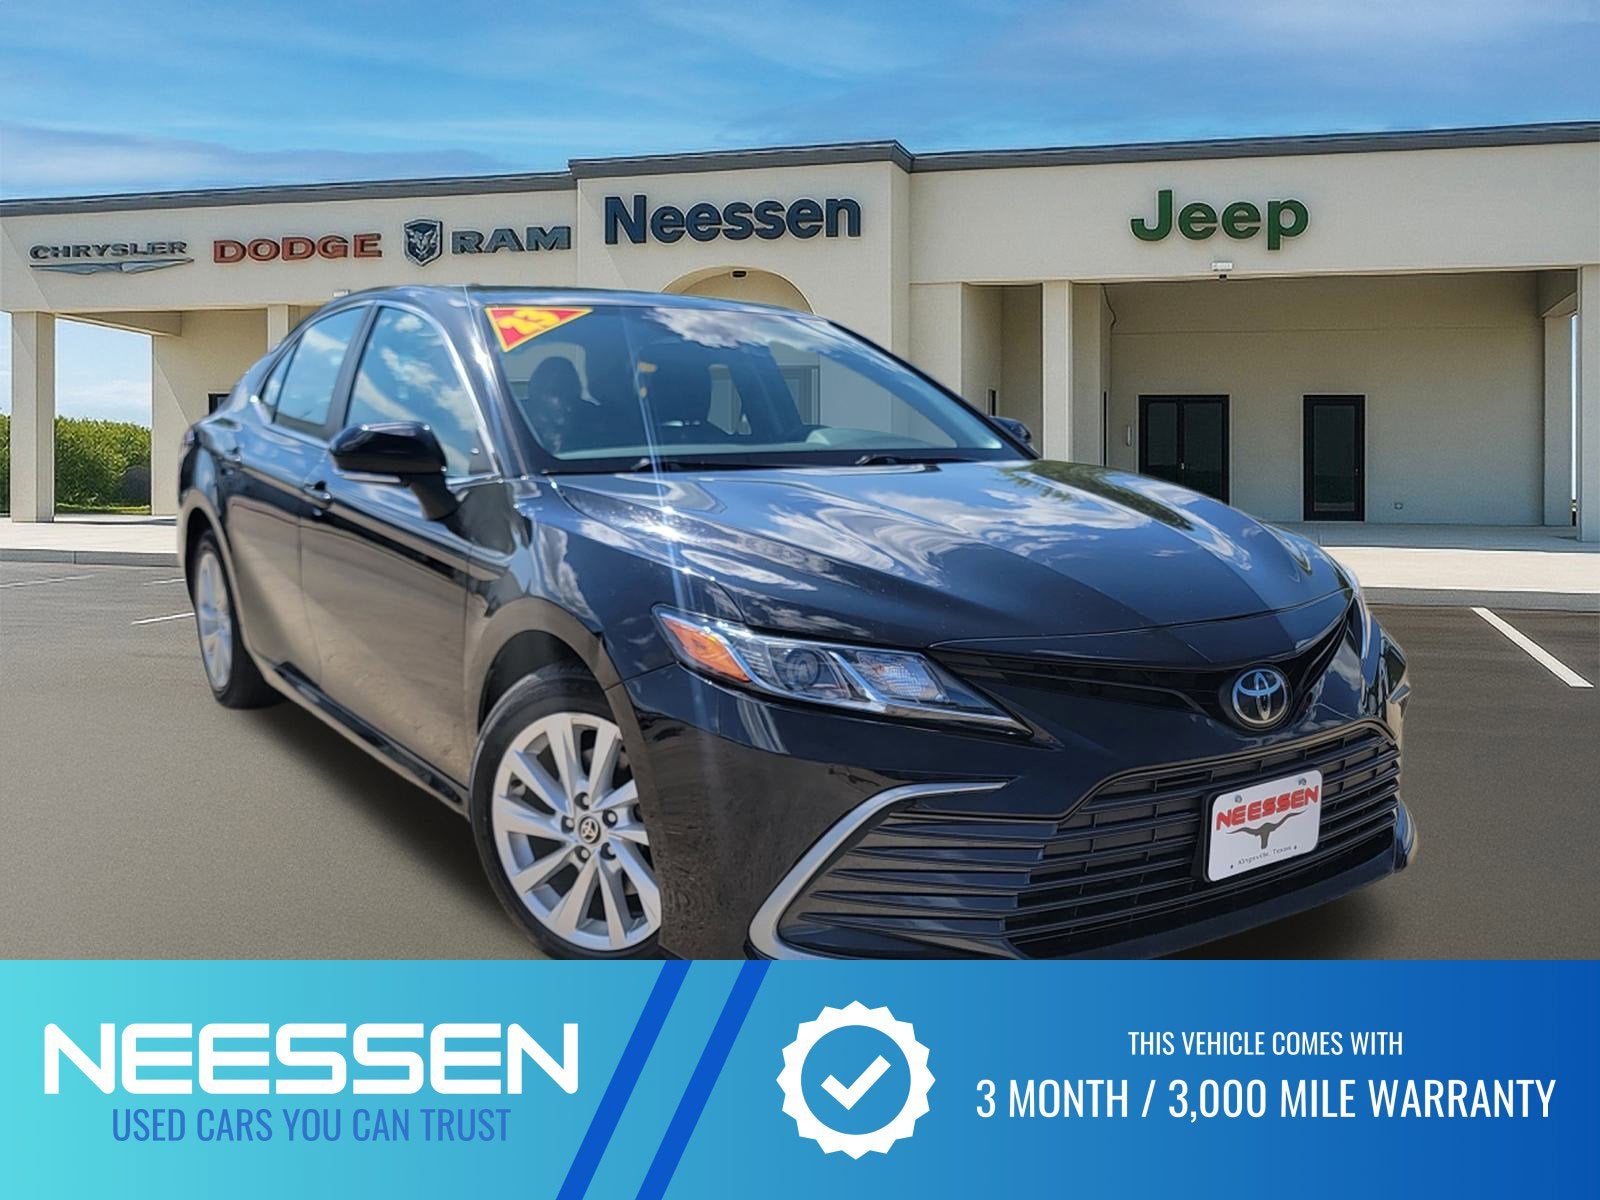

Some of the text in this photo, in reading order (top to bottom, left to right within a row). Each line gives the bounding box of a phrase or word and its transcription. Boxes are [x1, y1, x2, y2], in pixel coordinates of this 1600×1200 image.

[604, 195, 862, 245] Neessen
[1130, 190, 1309, 251] Jeep
[29, 241, 188, 259] CHRYSLER
[213, 233, 382, 264] DODGE
[451, 225, 571, 255] RAM
[1216, 785, 1319, 831] NEESSEN
